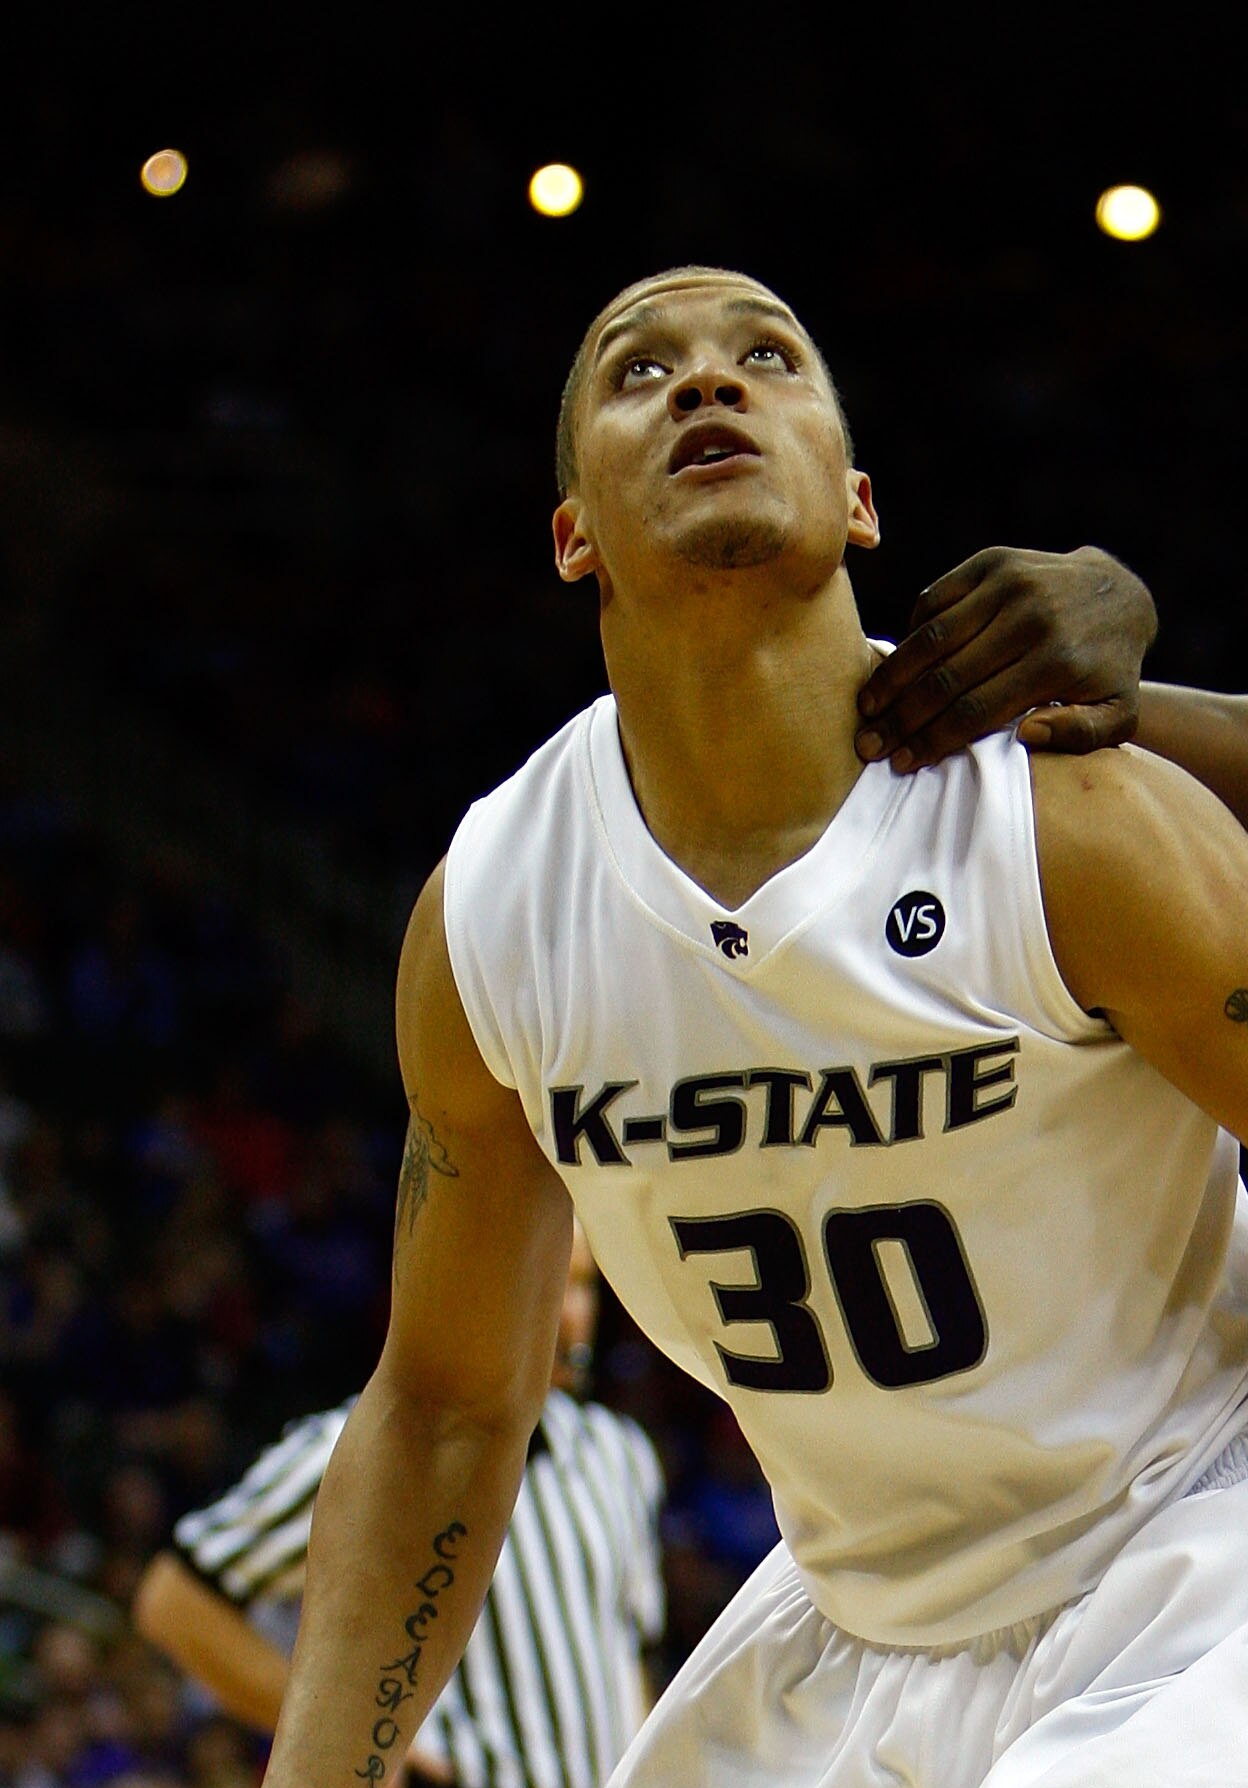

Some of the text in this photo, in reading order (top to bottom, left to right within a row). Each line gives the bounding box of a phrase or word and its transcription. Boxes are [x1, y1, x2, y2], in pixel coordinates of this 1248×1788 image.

[893, 904, 938, 944] VS
[548, 1035, 1020, 1167] K-STATE
[666, 1198, 990, 1395] 30
